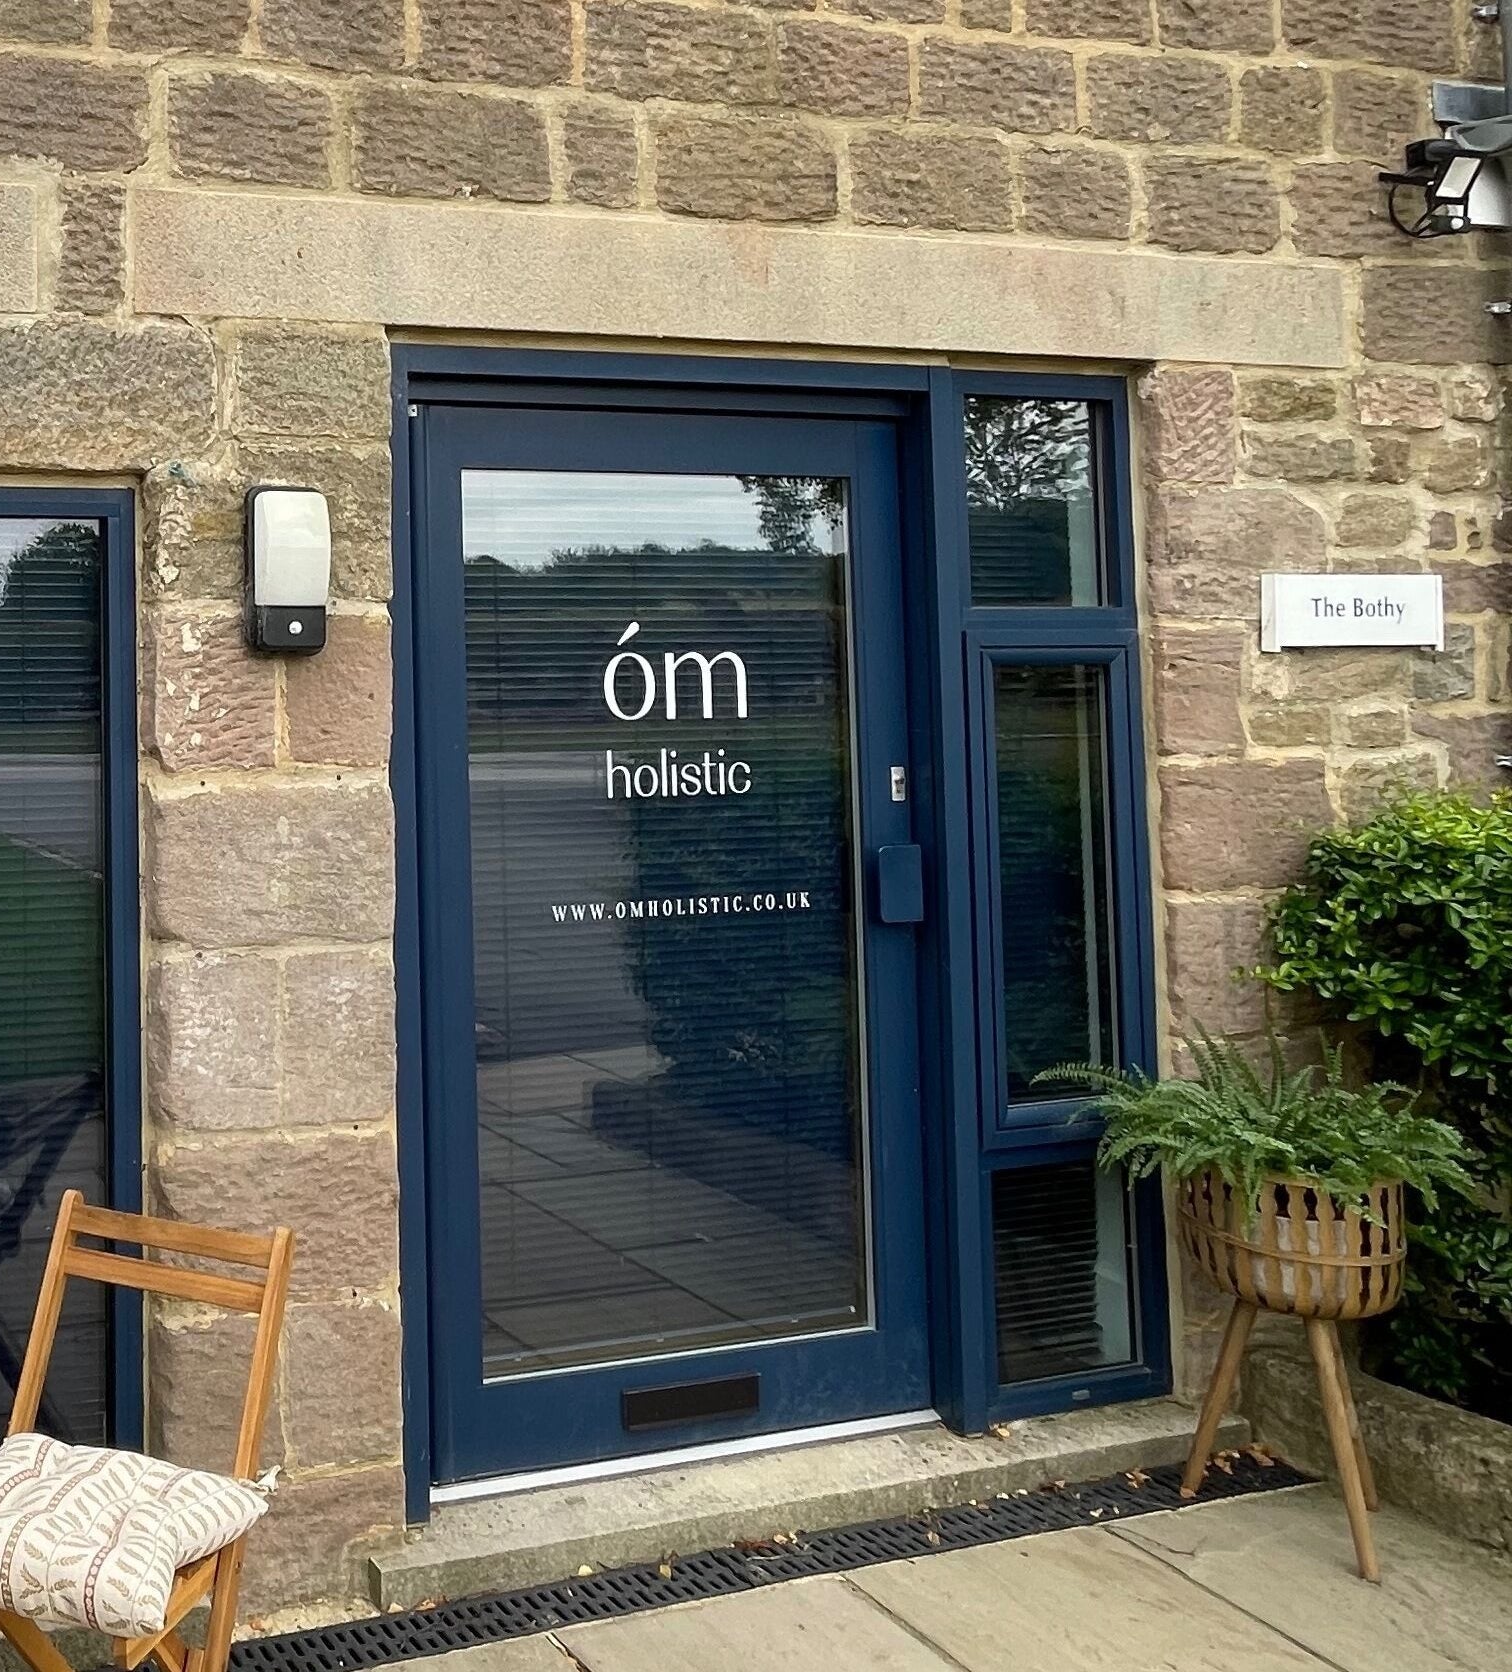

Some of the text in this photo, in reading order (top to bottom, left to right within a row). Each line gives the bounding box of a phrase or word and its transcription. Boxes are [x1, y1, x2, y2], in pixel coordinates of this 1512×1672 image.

[1310, 595, 1406, 624] The Bothy
[603, 621, 749, 721] óm
[605, 747, 752, 799] holistic
[551, 891, 811, 922] WWW.OMHOLISTIC.CO.UK
